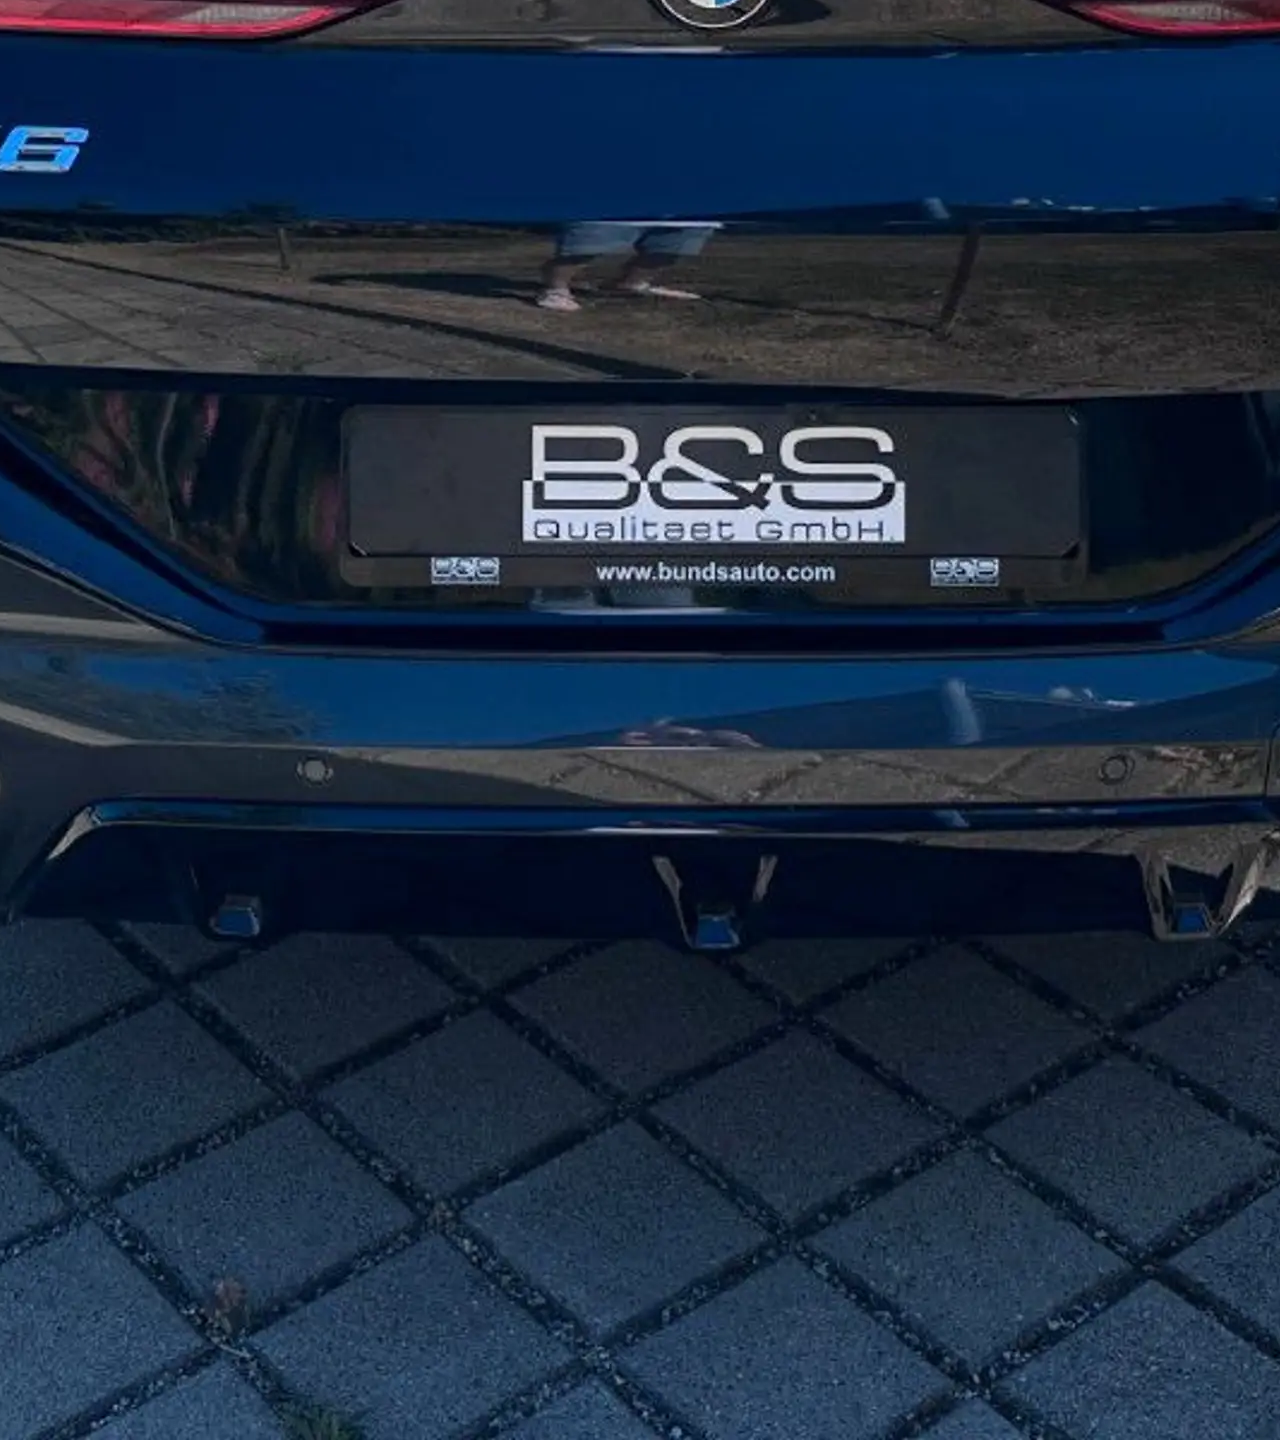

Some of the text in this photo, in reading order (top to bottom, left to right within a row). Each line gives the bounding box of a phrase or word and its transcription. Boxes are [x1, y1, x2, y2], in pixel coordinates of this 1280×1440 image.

[532, 425, 896, 511] B&S
[533, 516, 736, 541] Qualitaet
[596, 562, 836, 584] www.bundsauto.com
